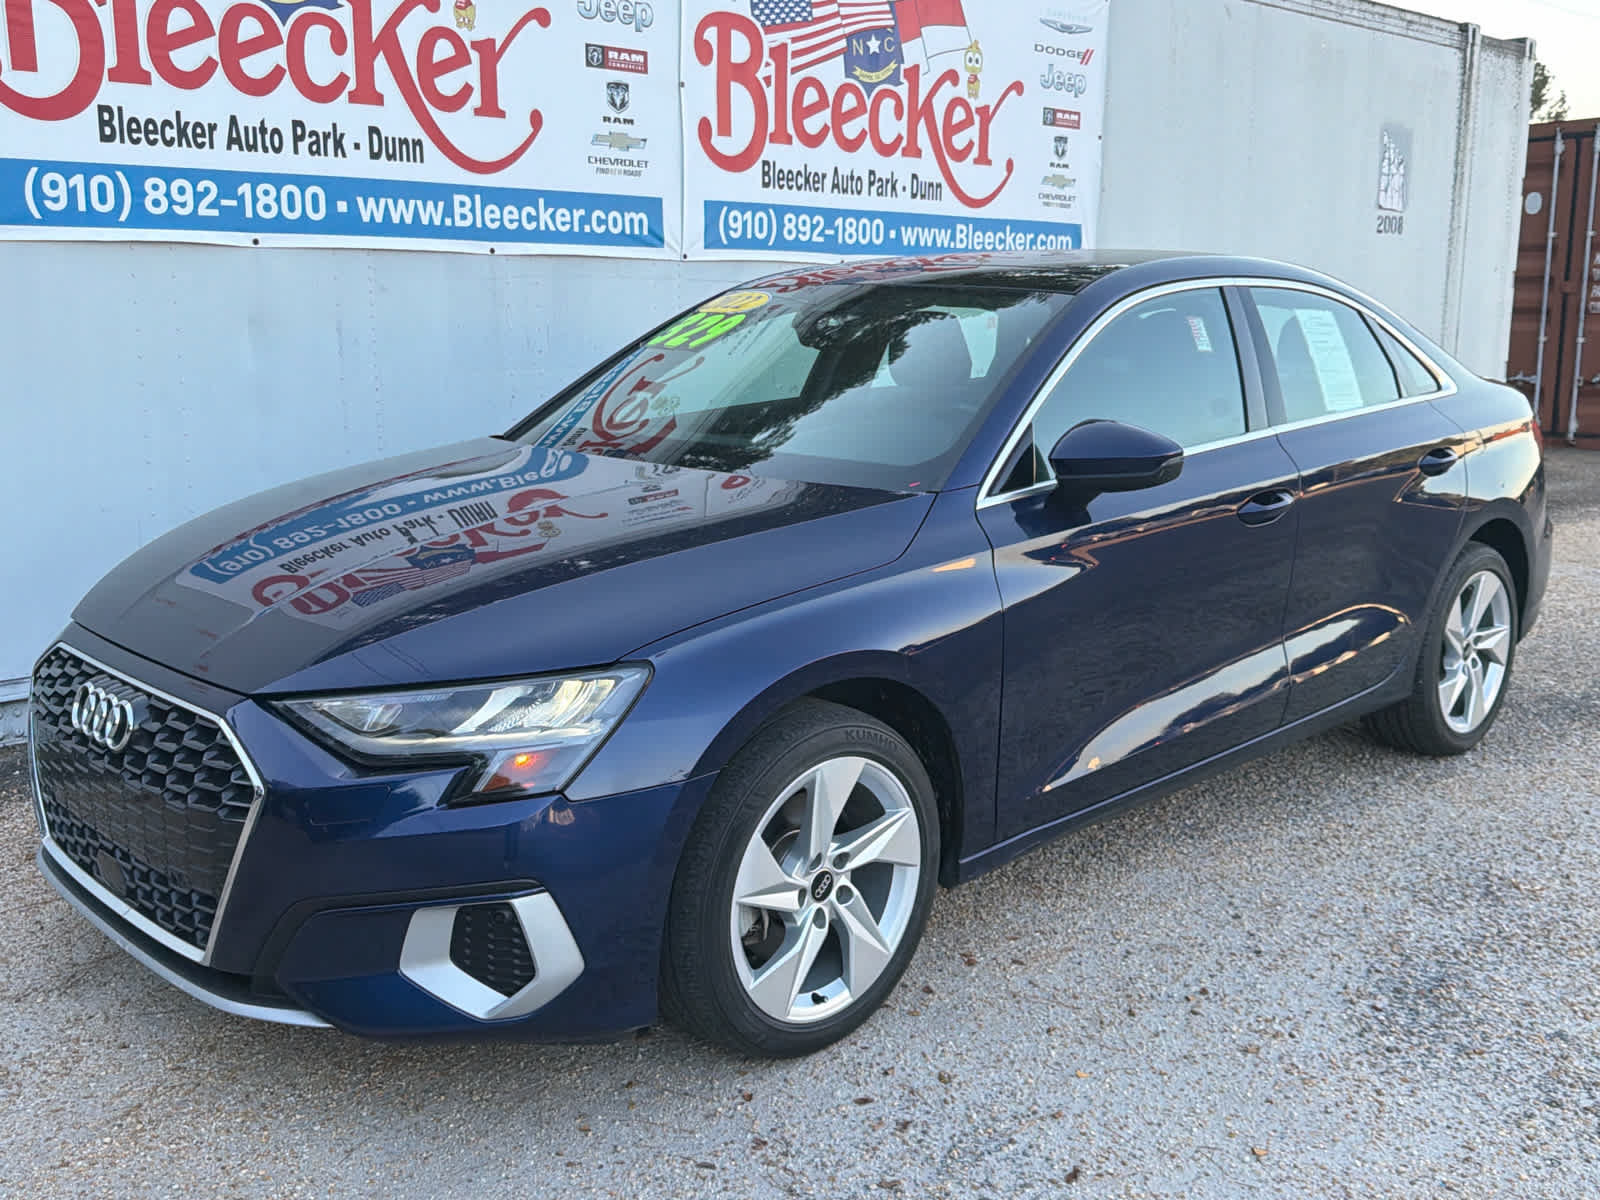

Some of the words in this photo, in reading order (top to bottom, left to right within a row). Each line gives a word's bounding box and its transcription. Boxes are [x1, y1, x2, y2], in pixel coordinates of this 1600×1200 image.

[577, 0, 654, 32] Jeep
[607, 50, 645, 63] RAM
[1033, 43, 1085, 60] DODGE
[1039, 63, 1087, 98] Jeep
[602, 115, 635, 126] RAM
[694, 11, 1024, 208] Bleecker
[97, 103, 218, 150] Bleecker
[226, 114, 284, 155] Auto
[291, 119, 348, 158] Park
[367, 125, 425, 164] Dunn
[587, 155, 649, 169] CHEVROLET
[761, 160, 827, 193] Bleecker
[831, 166, 864, 196] Auto
[868, 169, 899, 198] Park
[910, 173, 943, 202] Dunn
[24, 166, 132, 222] (910)
[143, 176, 327, 221] 892-1800
[356, 194, 649, 236] www.Bleecker.com
[719, 206, 777, 246] (910)
[783, 213, 885, 245] 892-1800
[900, 223, 1073, 250] www.Bleecker.com
